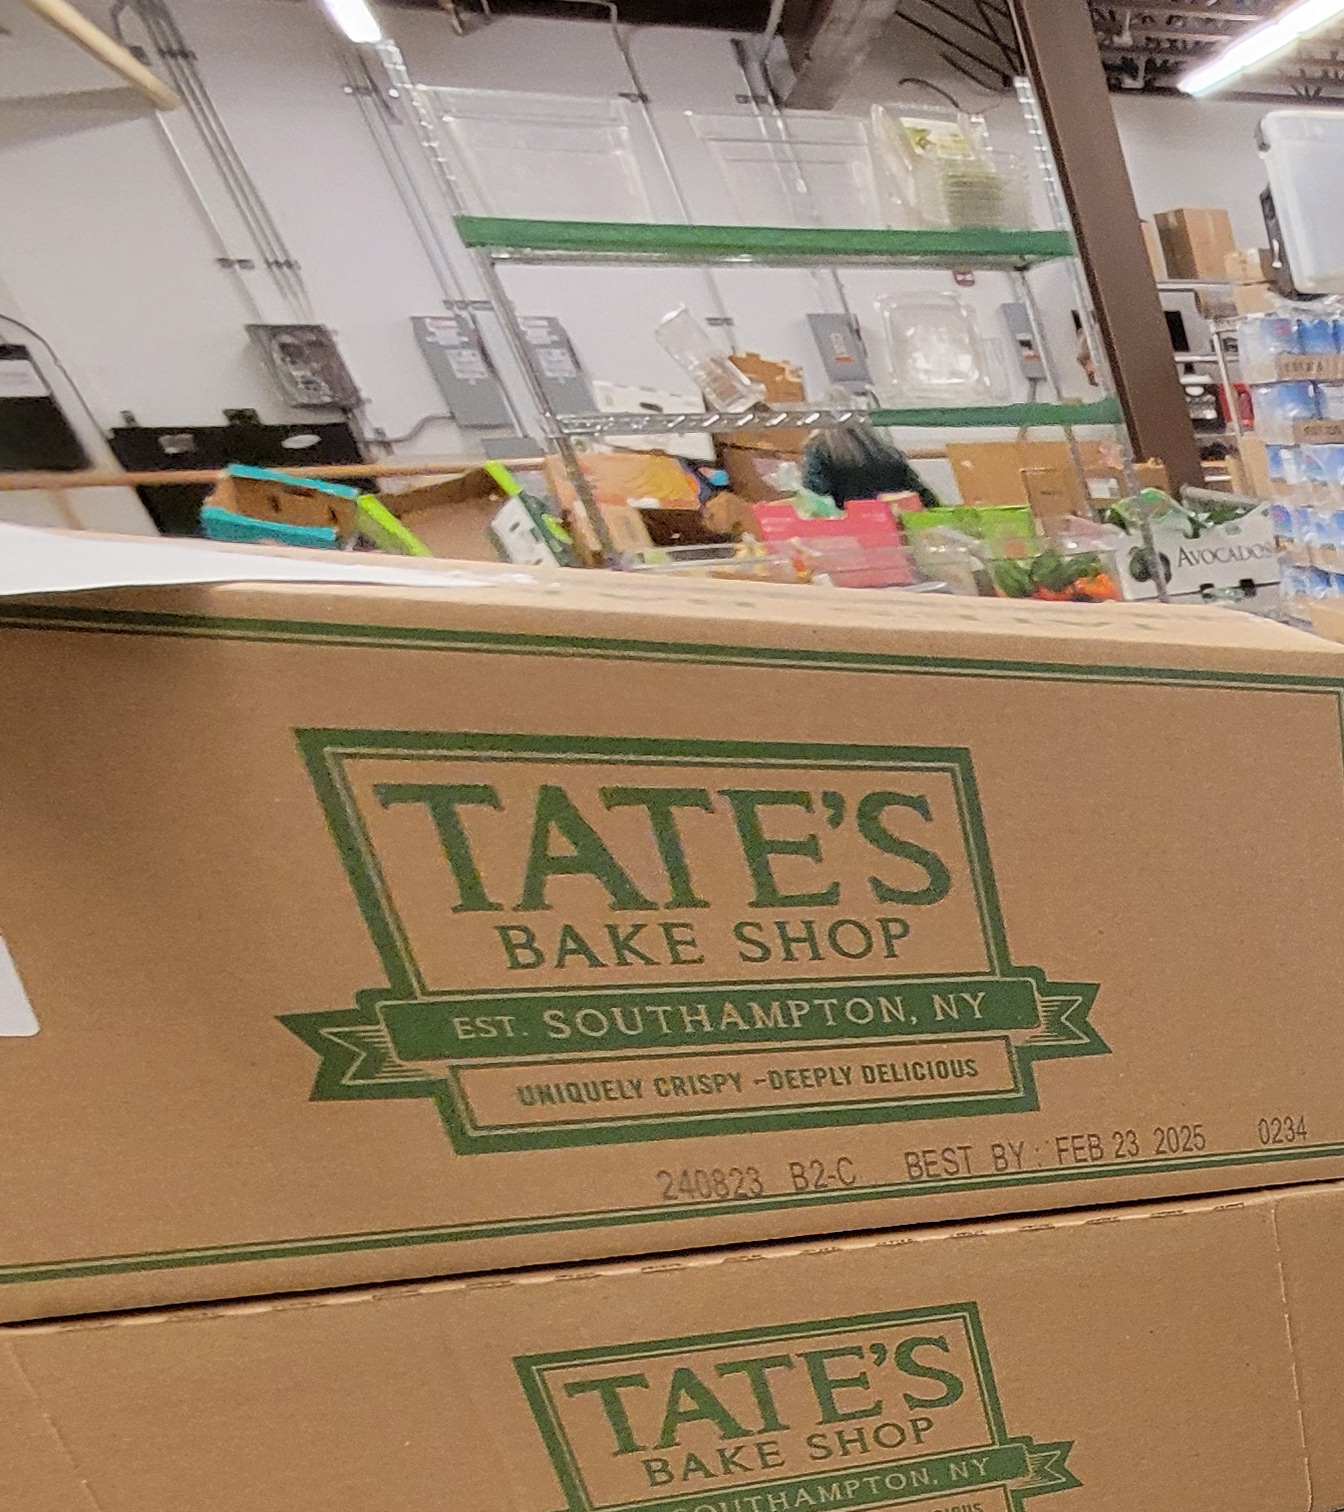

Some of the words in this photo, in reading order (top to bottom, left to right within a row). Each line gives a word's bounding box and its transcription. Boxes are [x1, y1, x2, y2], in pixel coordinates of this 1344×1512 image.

[374, 784, 953, 912] TATE'S
[495, 922, 706, 970] BAKE
[738, 917, 913, 966] SHOP
[454, 1013, 528, 1042] EST.
[542, 996, 918, 1041] SOUTHAMPTON,
[935, 992, 986, 1021] NY
[517, 1078, 644, 1107] UNIQUELY
[653, 1071, 743, 1100] CRISPY
[863, 1059, 979, 1086] DELICIOUS
[656, 1165, 765, 1200] 240823
[789, 1158, 857, 1191] B2-C
[905, 1146, 975, 1181] BEST
[1055, 1134, 1104, 1165] FEB
[1111, 1129, 1139, 1160] 23
[1153, 1123, 1207, 1155] 2025
[1257, 1116, 1308, 1147] 0234
[563, 1334, 966, 1457] TATE'S
[640, 1439, 786, 1487] BAKE
[809, 1414, 936, 1461] SHOP
[951, 1455, 990, 1484] NY
